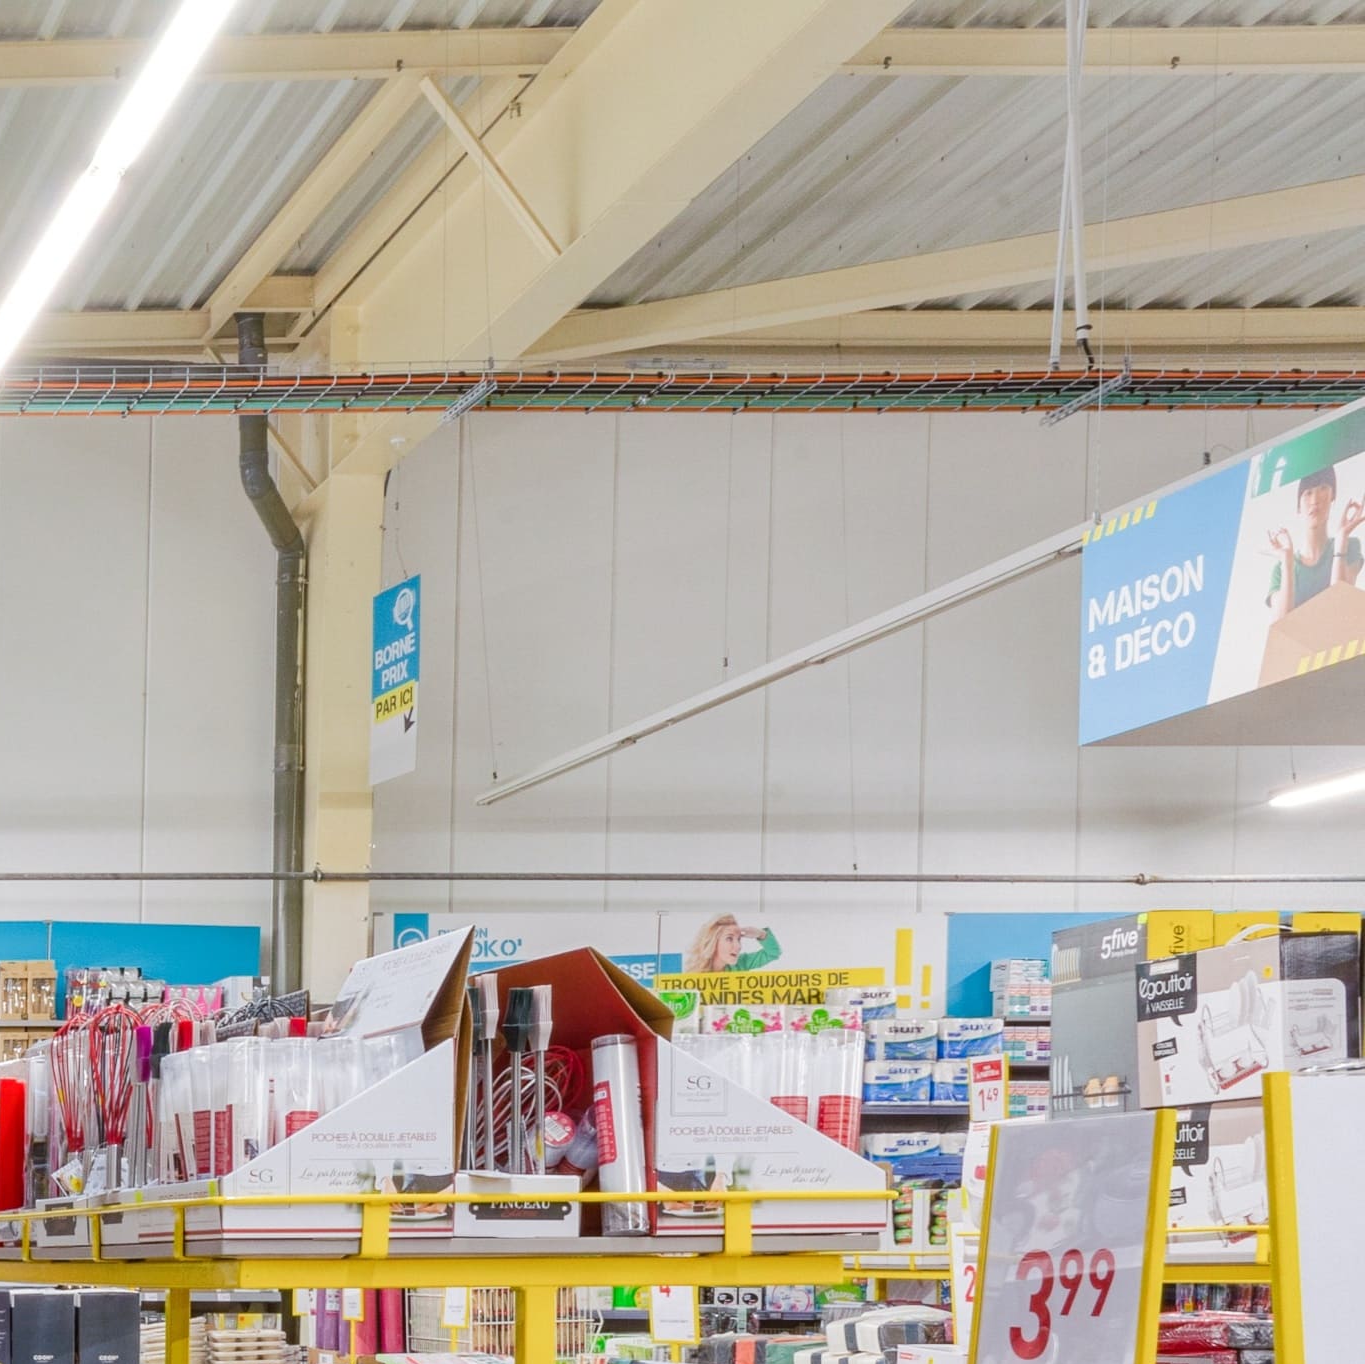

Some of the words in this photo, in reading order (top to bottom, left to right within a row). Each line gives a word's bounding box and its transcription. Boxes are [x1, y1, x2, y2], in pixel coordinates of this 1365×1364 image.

[1088, 554, 1205, 634] MAISON
[374, 632, 416, 670] BORNE
[1087, 644, 1107, 679] &
[1115, 611, 1197, 671] DÉCO
[381, 659, 409, 690] PRIX
[376, 695, 398, 719] PAR
[400, 686, 413, 707] ICI
[661, 976, 730, 991] TROUVE
[737, 972, 822, 988] TOUJOURS
[829, 971, 850, 986] DE
[1152, 996, 1186, 1012] VAISSELLE
[1173, 1119, 1206, 1143] uttoir
